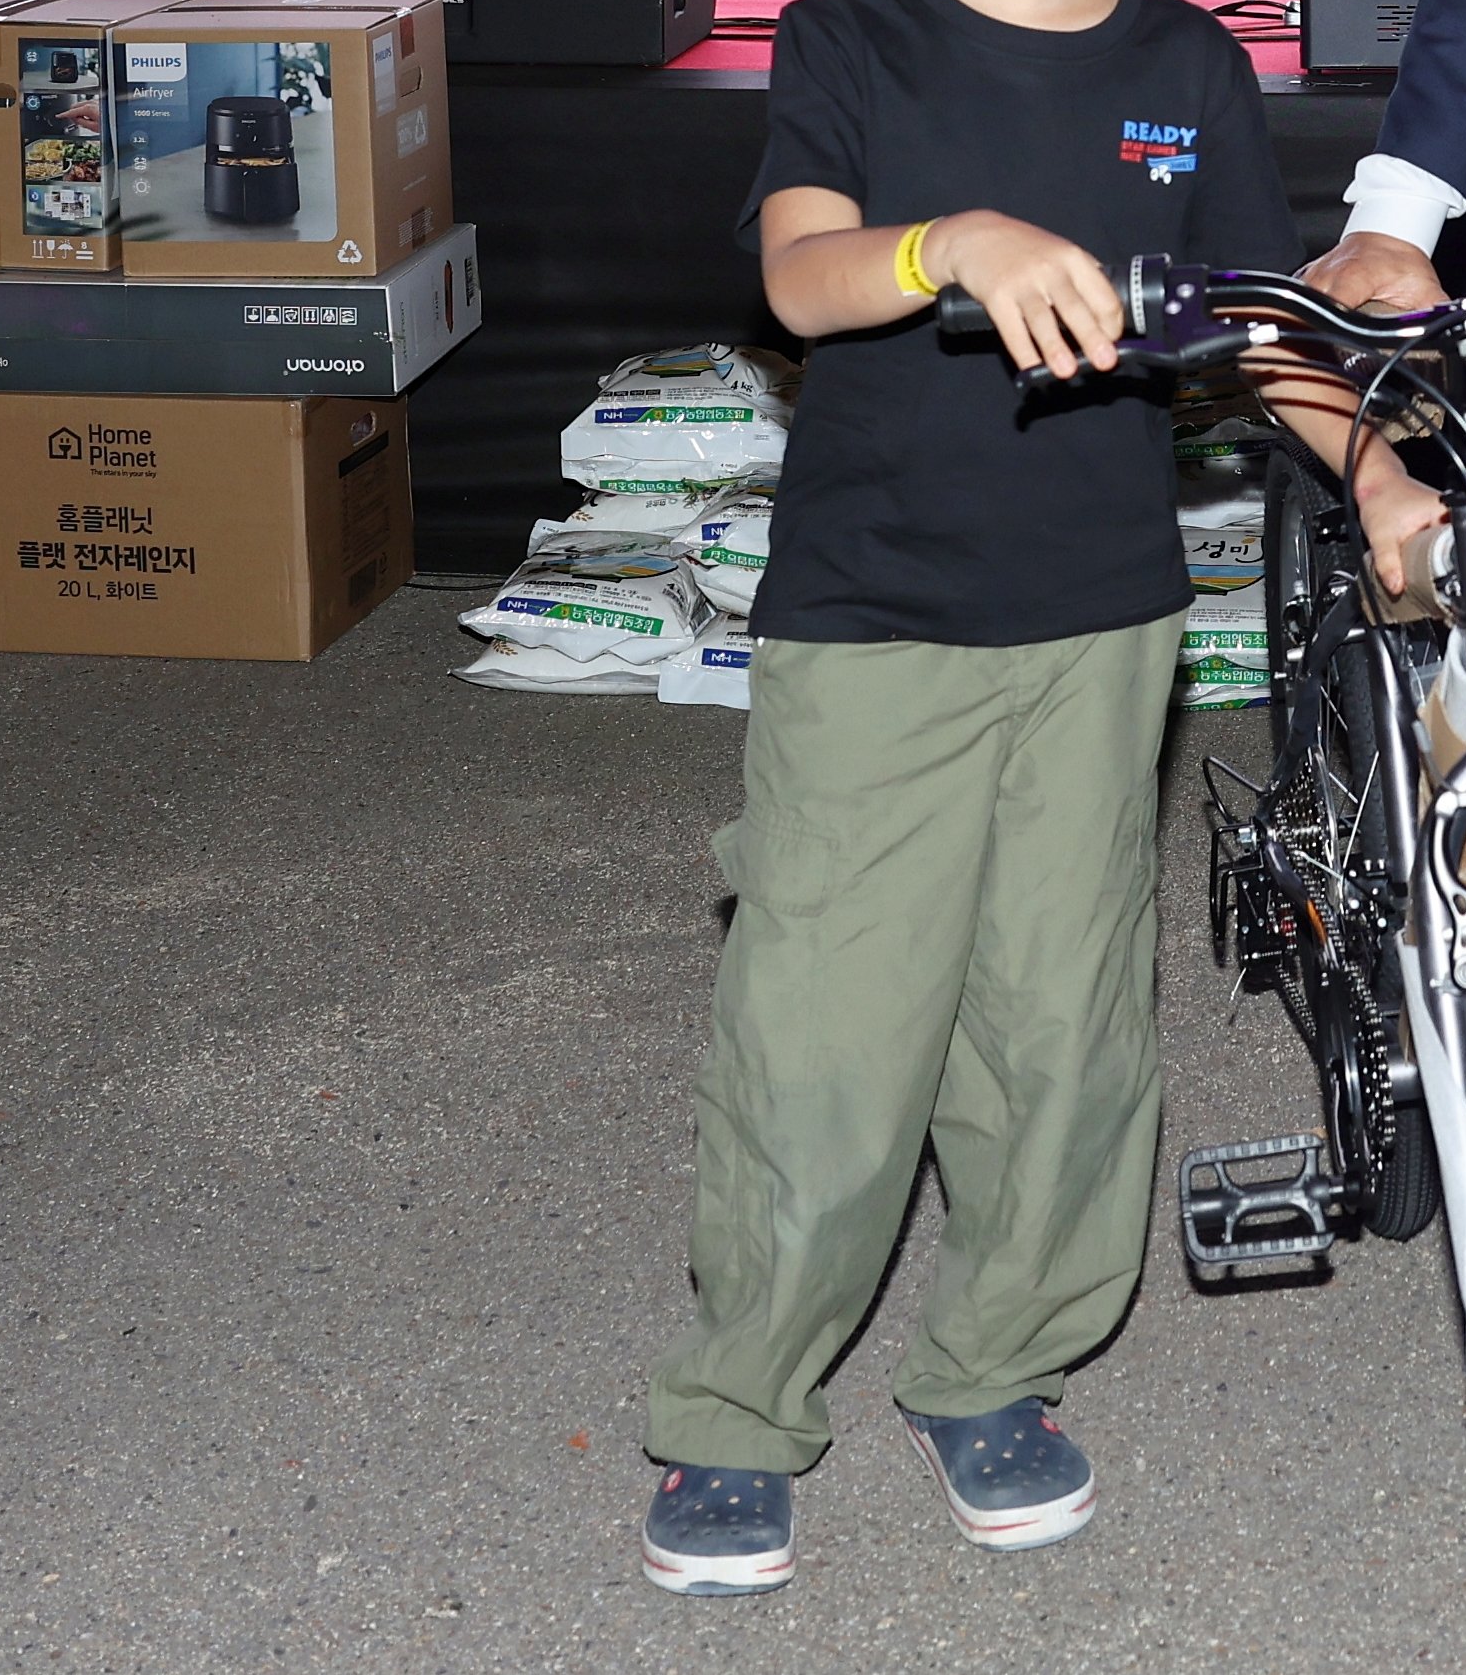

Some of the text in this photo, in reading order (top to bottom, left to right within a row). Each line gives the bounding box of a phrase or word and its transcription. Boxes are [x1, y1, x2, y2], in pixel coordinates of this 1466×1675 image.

[131, 57, 182, 68] PHILIPS
[133, 87, 174, 99] Airfryer
[134, 109, 170, 117] 1000 Series
[1123, 120, 1198, 147] READY
[286, 356, 365, 374] atoman
[730, 380, 753, 392] 4 kg
[603, 411, 623, 420] NH
[88, 424, 152, 446] Home
[89, 447, 157, 468] Planet
[56, 504, 154, 535] 홈플래닛
[17, 542, 196, 575] 플랫 전자레인지
[57, 580, 159, 601] 20 L, 화이트
[507, 600, 528, 610] NH
[1190, 633, 1268, 646] 능주농업협동조
[711, 652, 733, 663] NH
